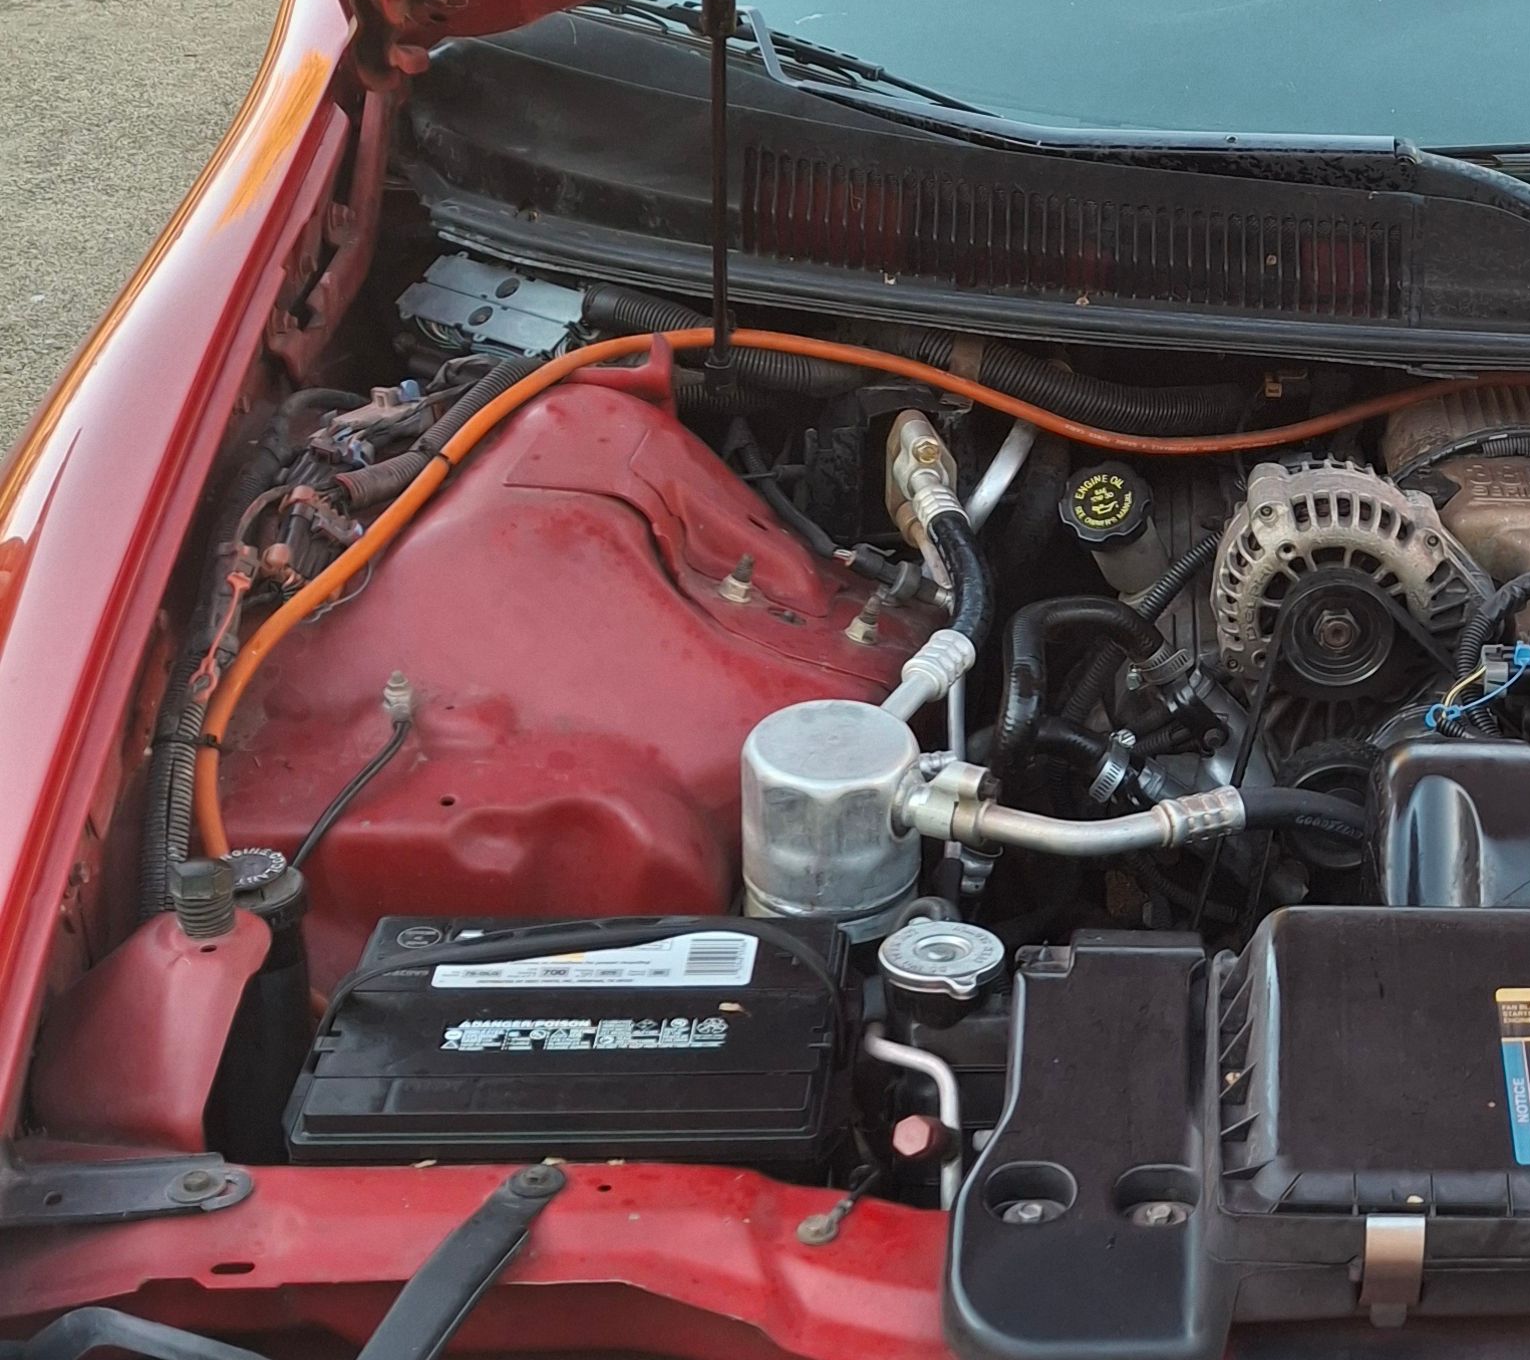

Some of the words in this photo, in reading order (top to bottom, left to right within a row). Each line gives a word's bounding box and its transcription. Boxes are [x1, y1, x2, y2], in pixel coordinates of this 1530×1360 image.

[1074, 474, 1108, 500] ENGINE
[1109, 475, 1125, 489] OIL
[1513, 1078, 1530, 1123] NOTICE
